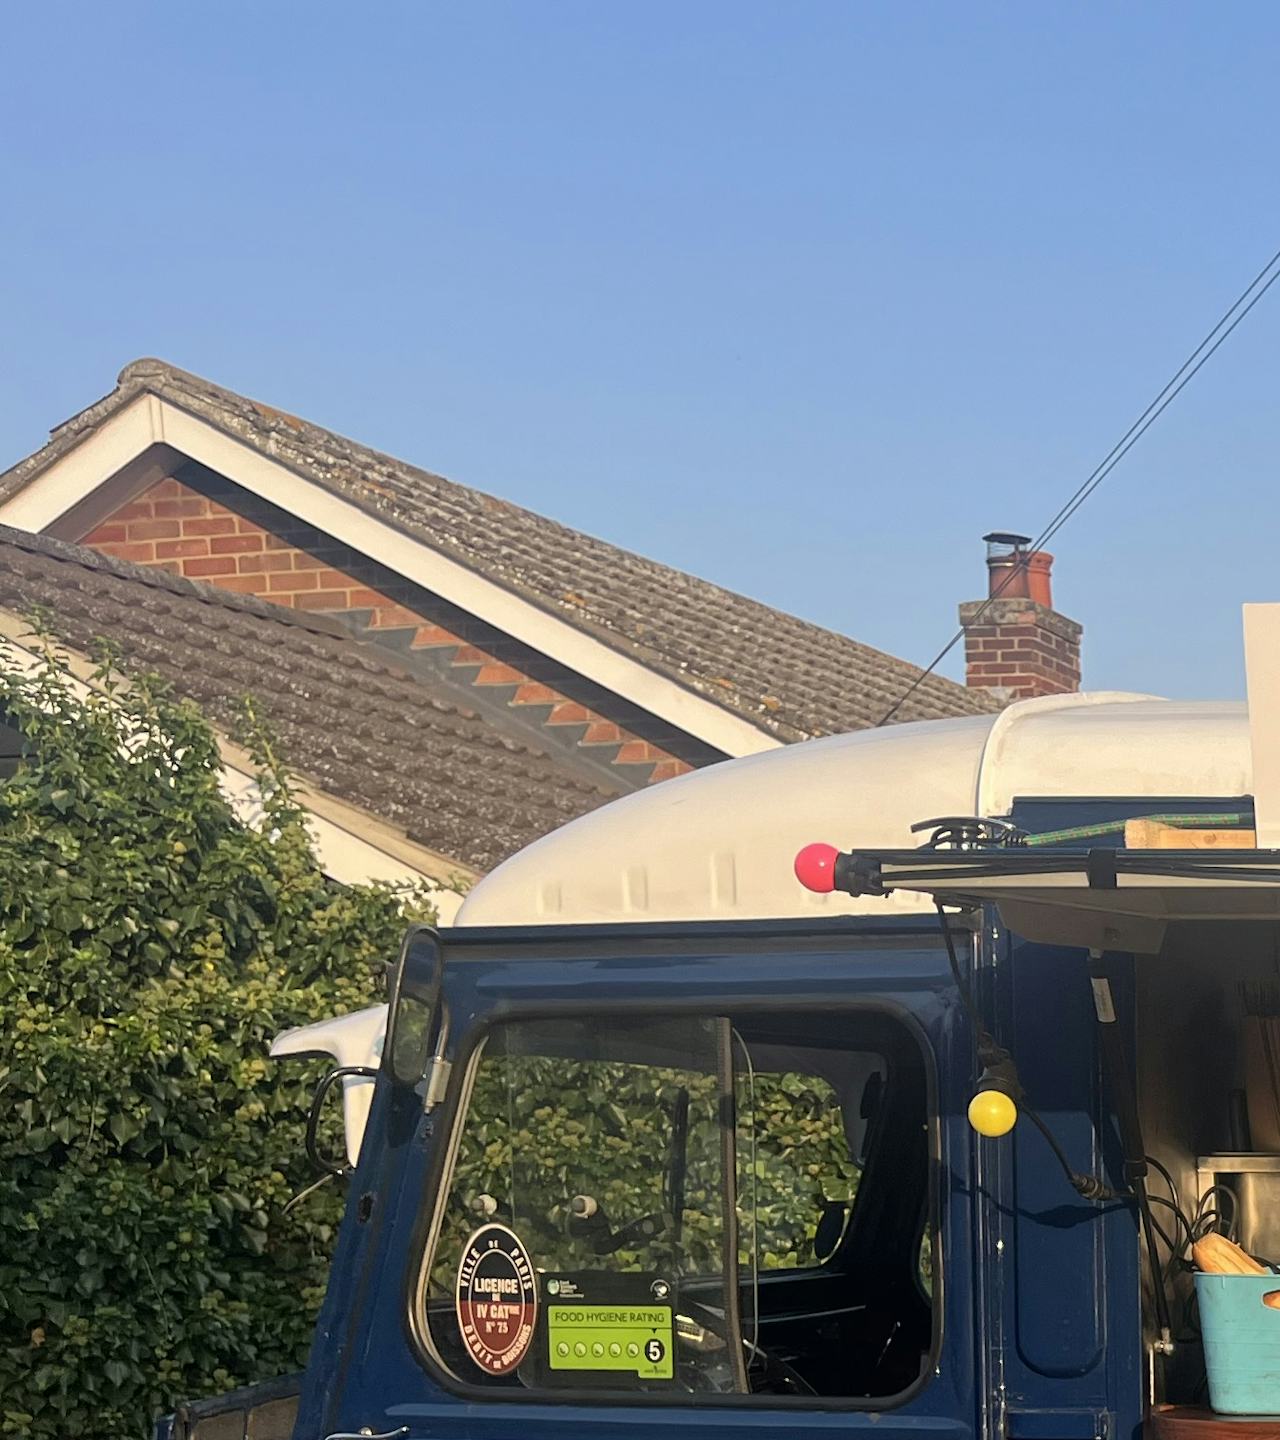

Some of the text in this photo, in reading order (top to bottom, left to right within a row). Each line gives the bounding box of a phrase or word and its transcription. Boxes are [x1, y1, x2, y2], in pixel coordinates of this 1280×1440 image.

[460, 1247, 481, 1288] VILLE
[510, 1247, 533, 1290] PARIS
[474, 1277, 519, 1294] LICENCE
[477, 1304, 488, 1319] IV
[555, 1311, 665, 1323] FOOD HYGIENE RATING
[464, 1324, 493, 1365] DEBIT
[501, 1324, 532, 1366] BOISSONS
[648, 1341, 661, 1361] 5
